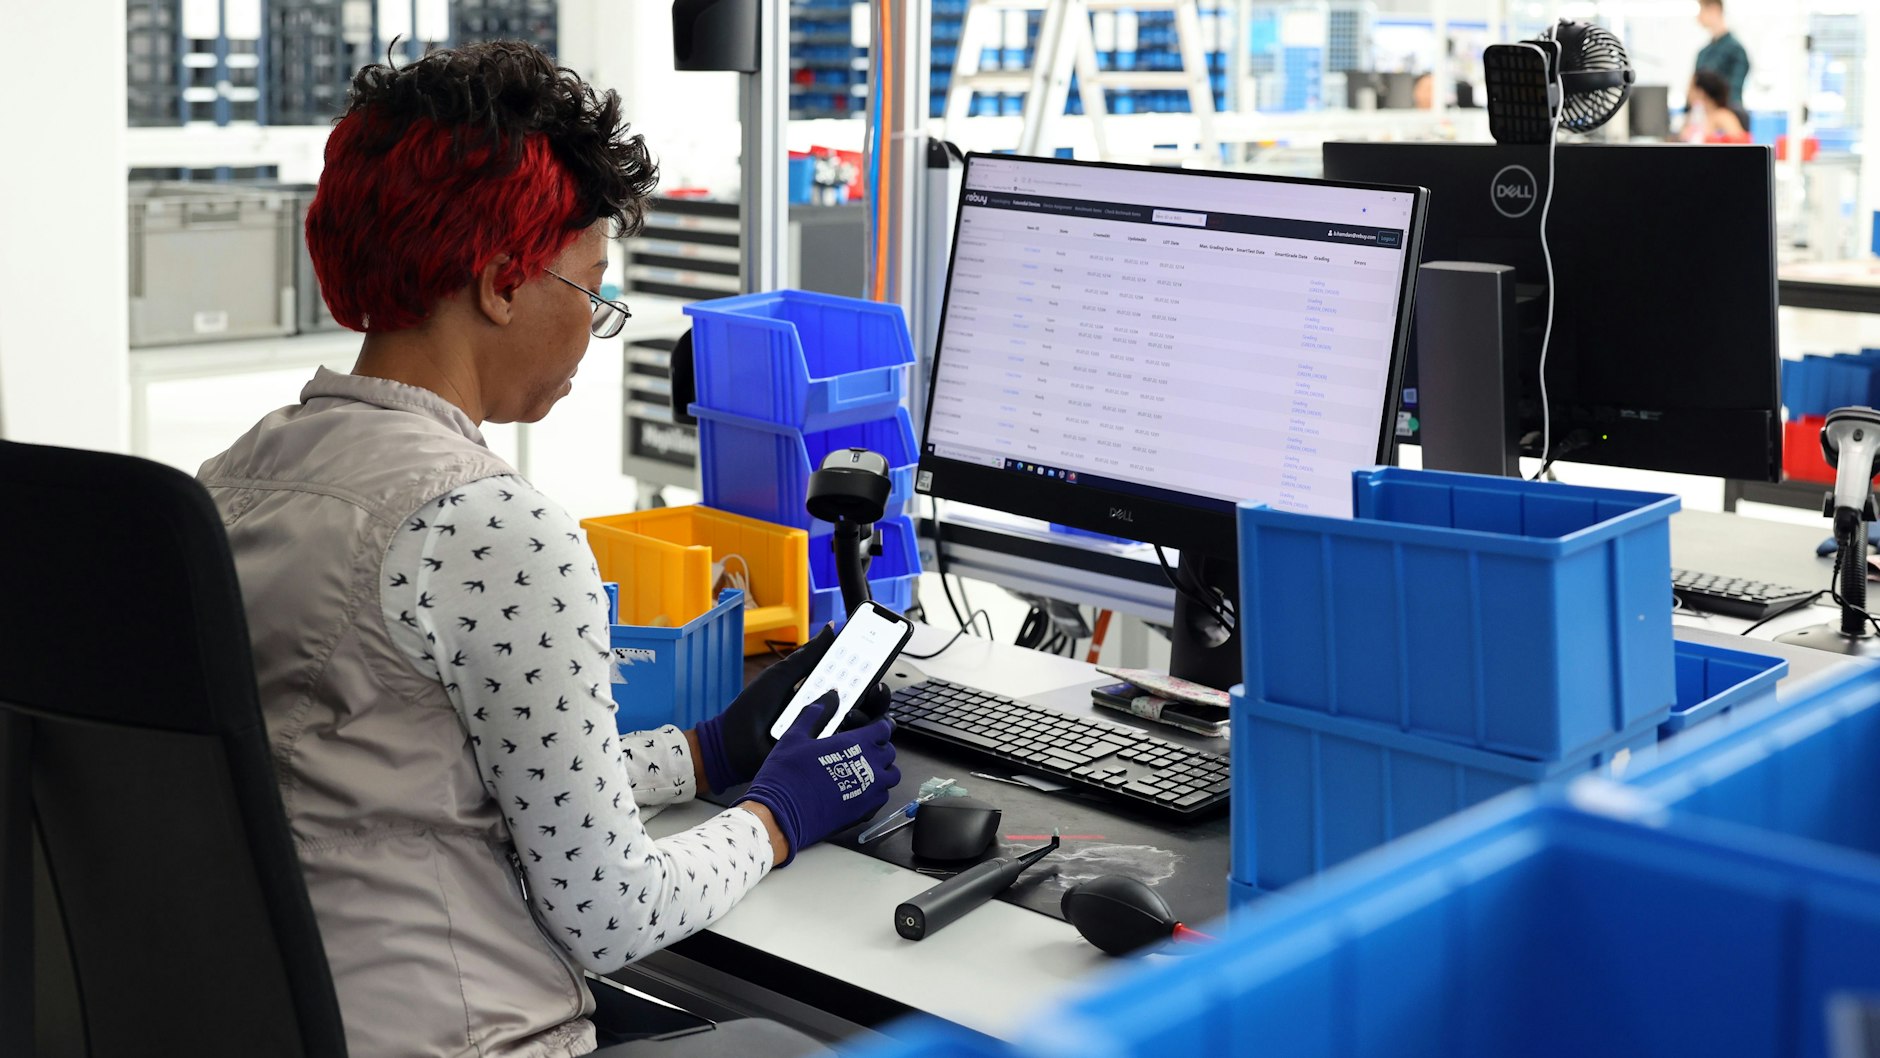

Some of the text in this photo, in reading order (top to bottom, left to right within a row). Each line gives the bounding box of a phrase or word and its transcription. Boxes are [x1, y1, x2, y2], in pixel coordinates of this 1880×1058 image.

[1497, 185, 1531, 198] DELL
[966, 193, 988, 205] rebuy
[1109, 507, 1134, 522] DELL
[844, 780, 852, 789] CE
